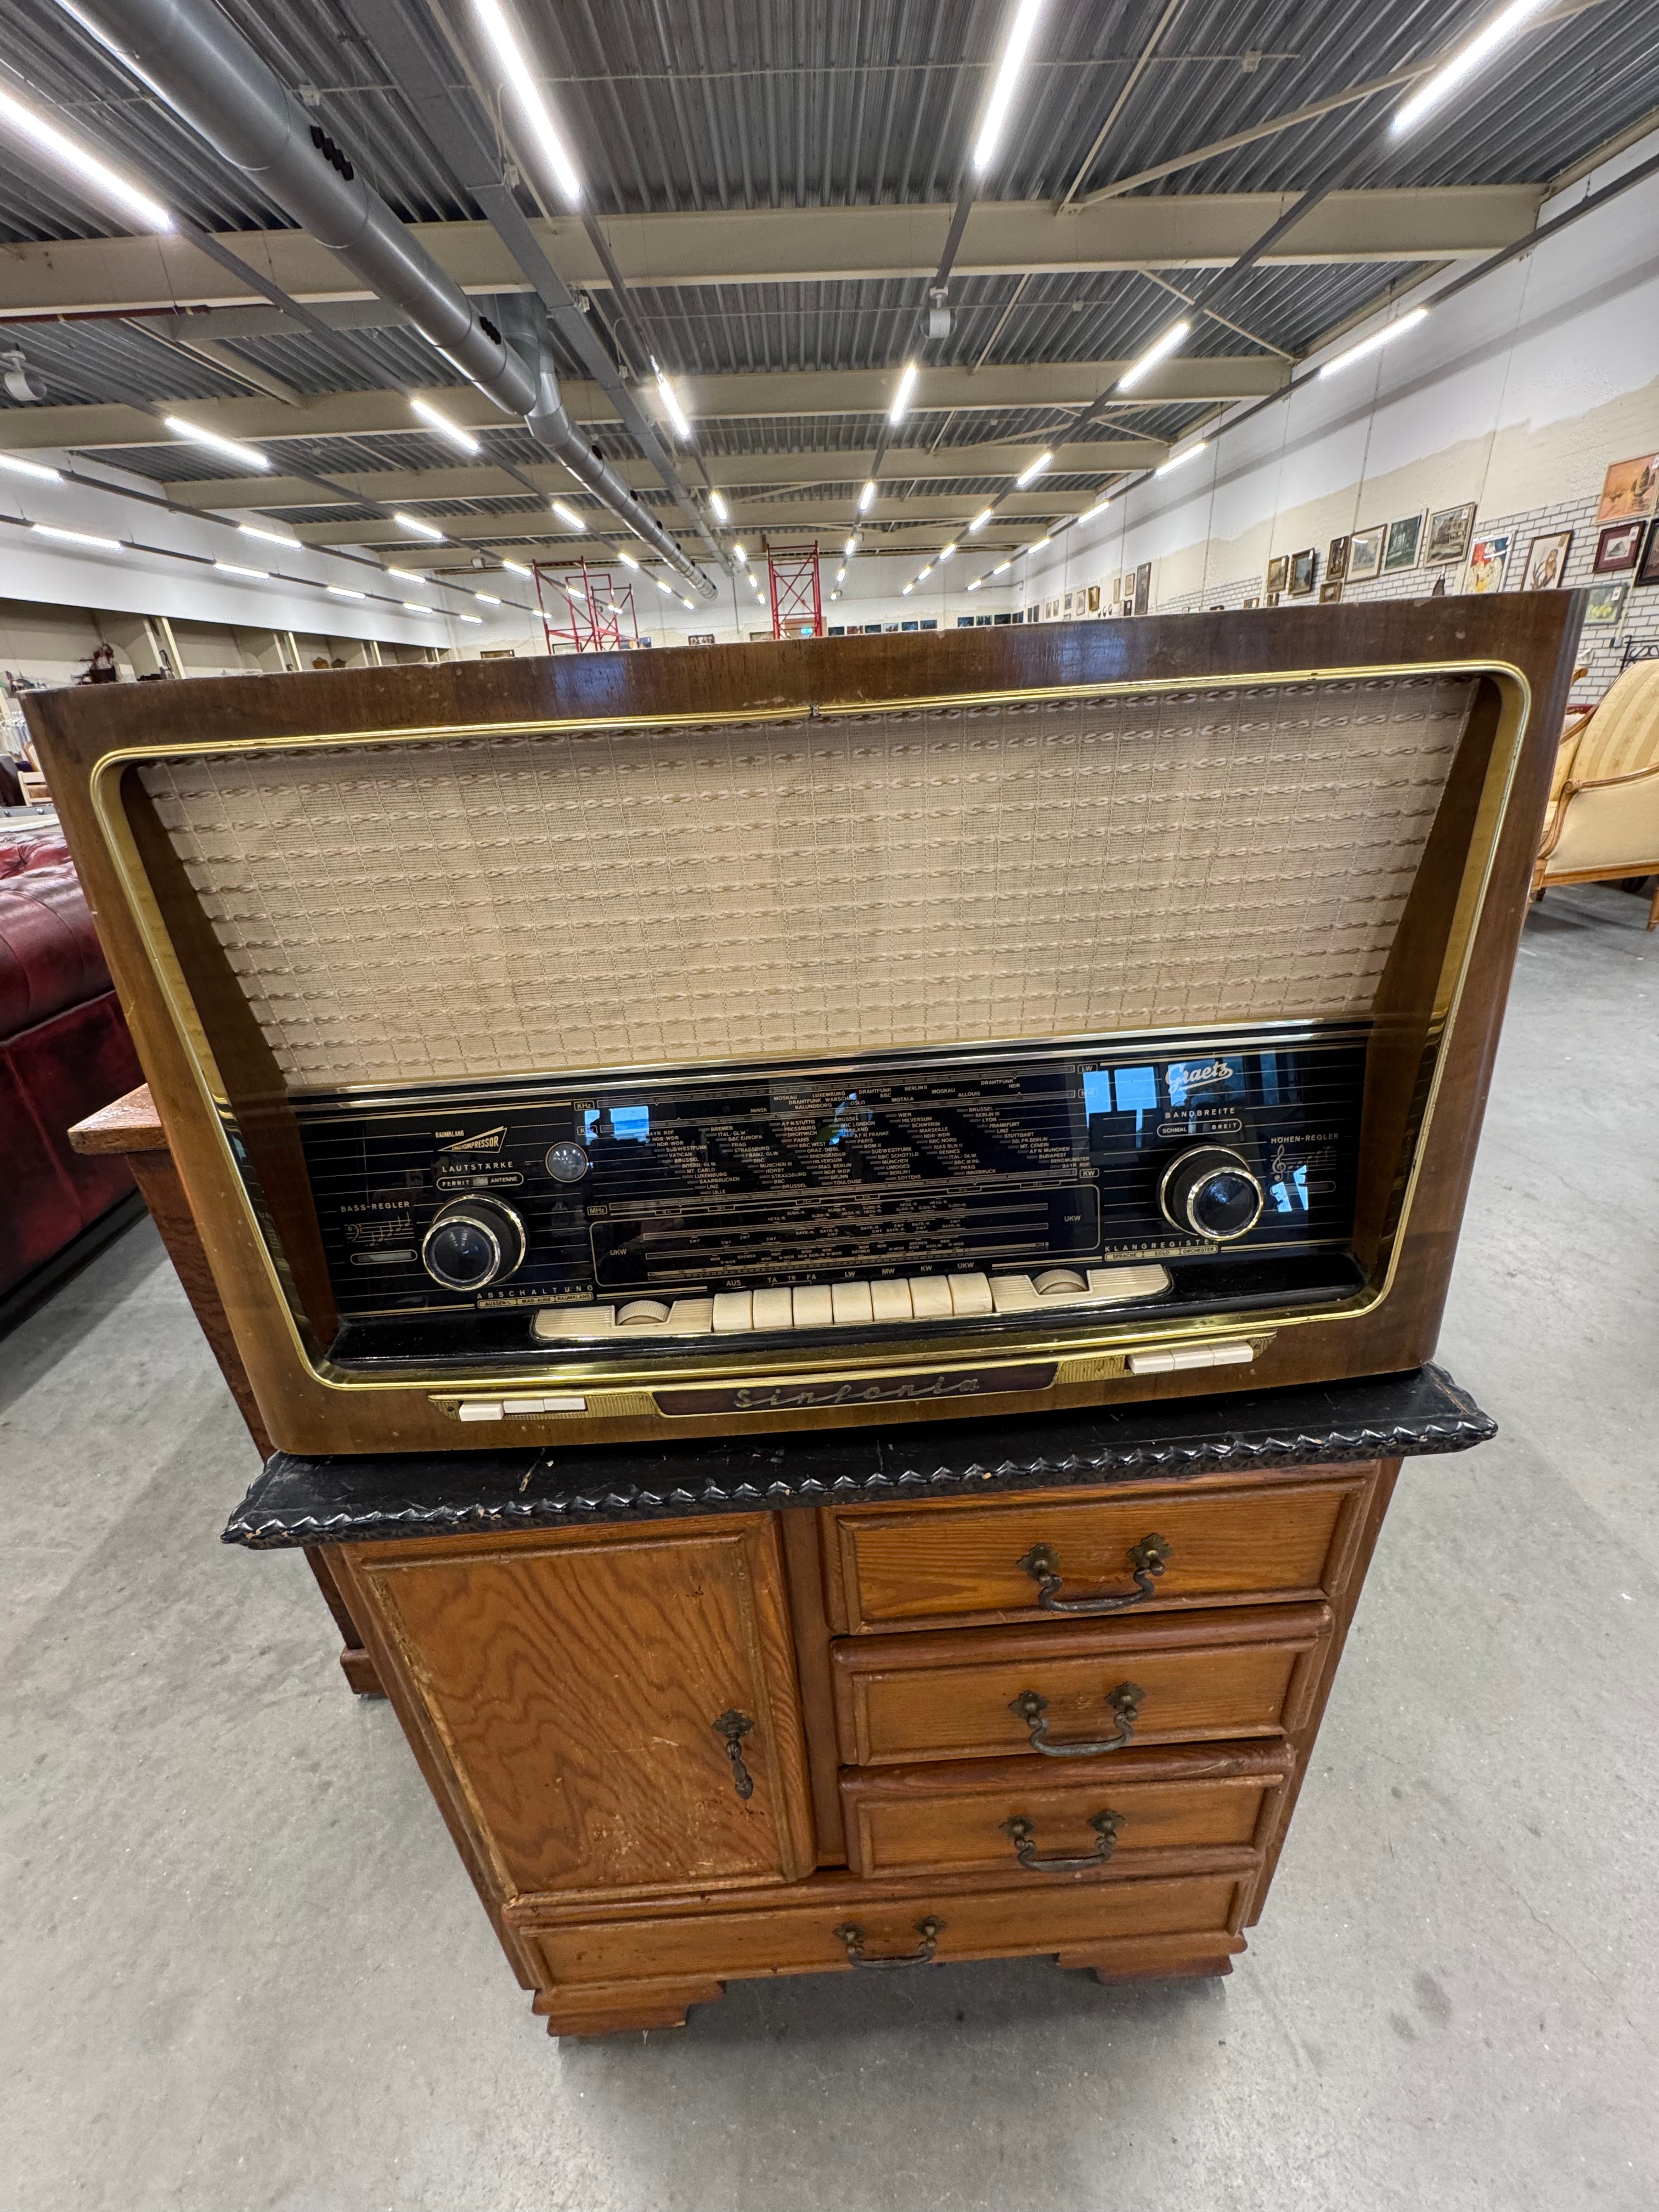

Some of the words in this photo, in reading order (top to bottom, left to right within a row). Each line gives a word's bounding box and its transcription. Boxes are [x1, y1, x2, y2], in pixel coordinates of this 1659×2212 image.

[1165, 1060, 1233, 1094] Graetz
[1165, 1107, 1235, 1119] BANDBREITE
[1271, 1133, 1339, 1144] HÖHEN-REGLER
[442, 1161, 514, 1172] LAUTSTÄRKE
[341, 1201, 410, 1212] BASS-REGLER
[1104, 1239, 1219, 1252] KLANGREGISTE
[477, 1284, 593, 1300] ABSCHALTUNG
[733, 1376, 980, 1408] Sinfonia
